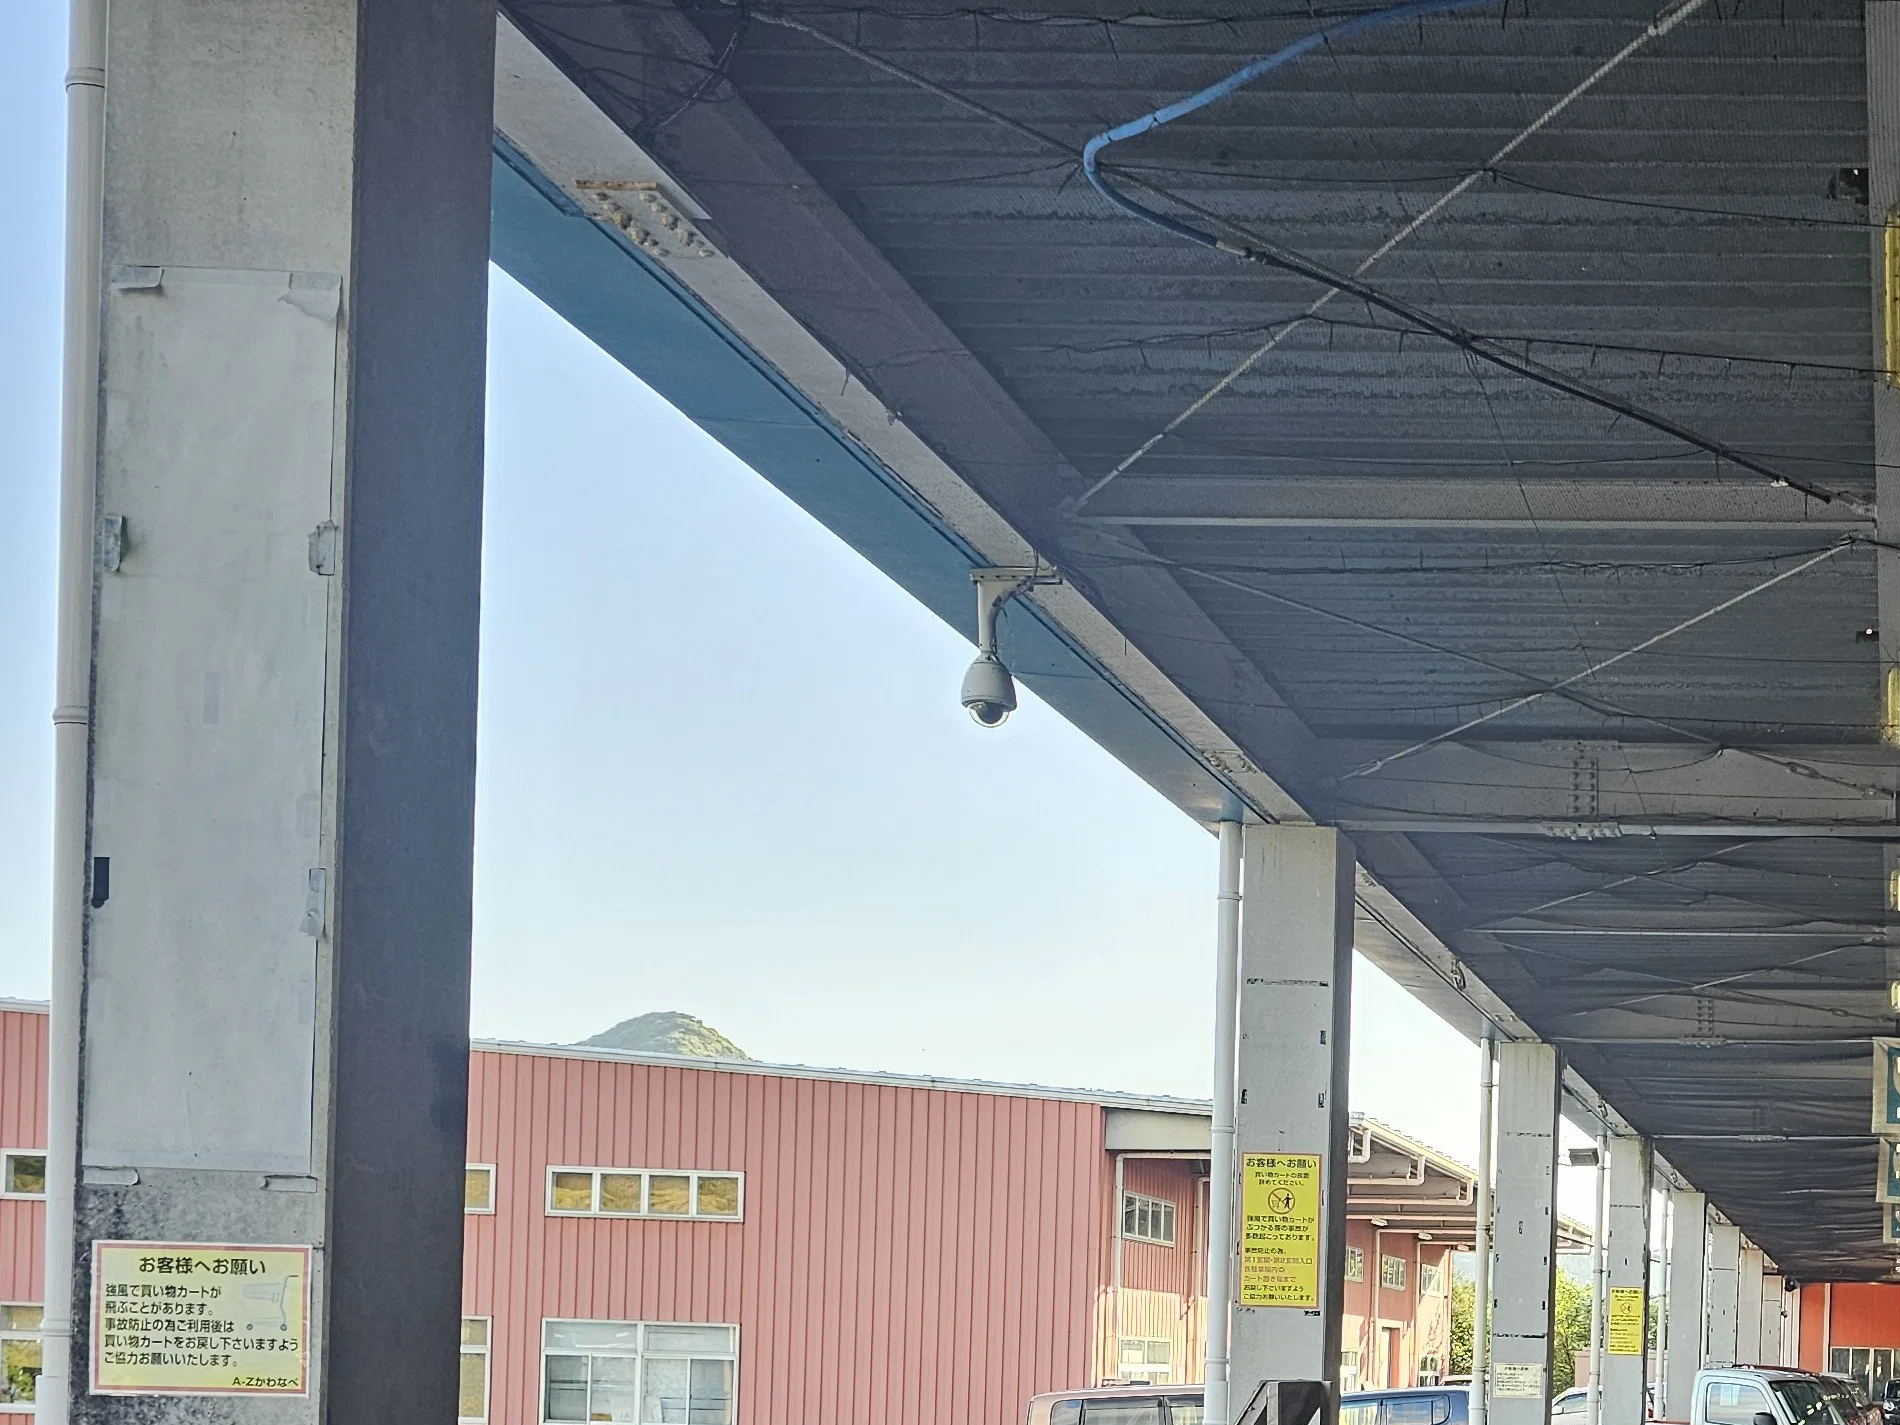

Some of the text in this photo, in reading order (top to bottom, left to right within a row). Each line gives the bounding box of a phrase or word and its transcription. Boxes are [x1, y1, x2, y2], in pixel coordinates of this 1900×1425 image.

[139, 1258, 266, 1275] お客様へお願い
[105, 1283, 221, 1298] 強風で買い物カートが
[105, 1301, 214, 1316] 飛ぶことがあります。
[105, 1319, 234, 1333] 事故防止の為ご利用後は
[104, 1335, 298, 1351] 買い物カートをお戻し下さいますよう
[104, 1352, 238, 1367] ご協力お願いいたします。
[232, 1377, 299, 1388] A-Zかわなべ
